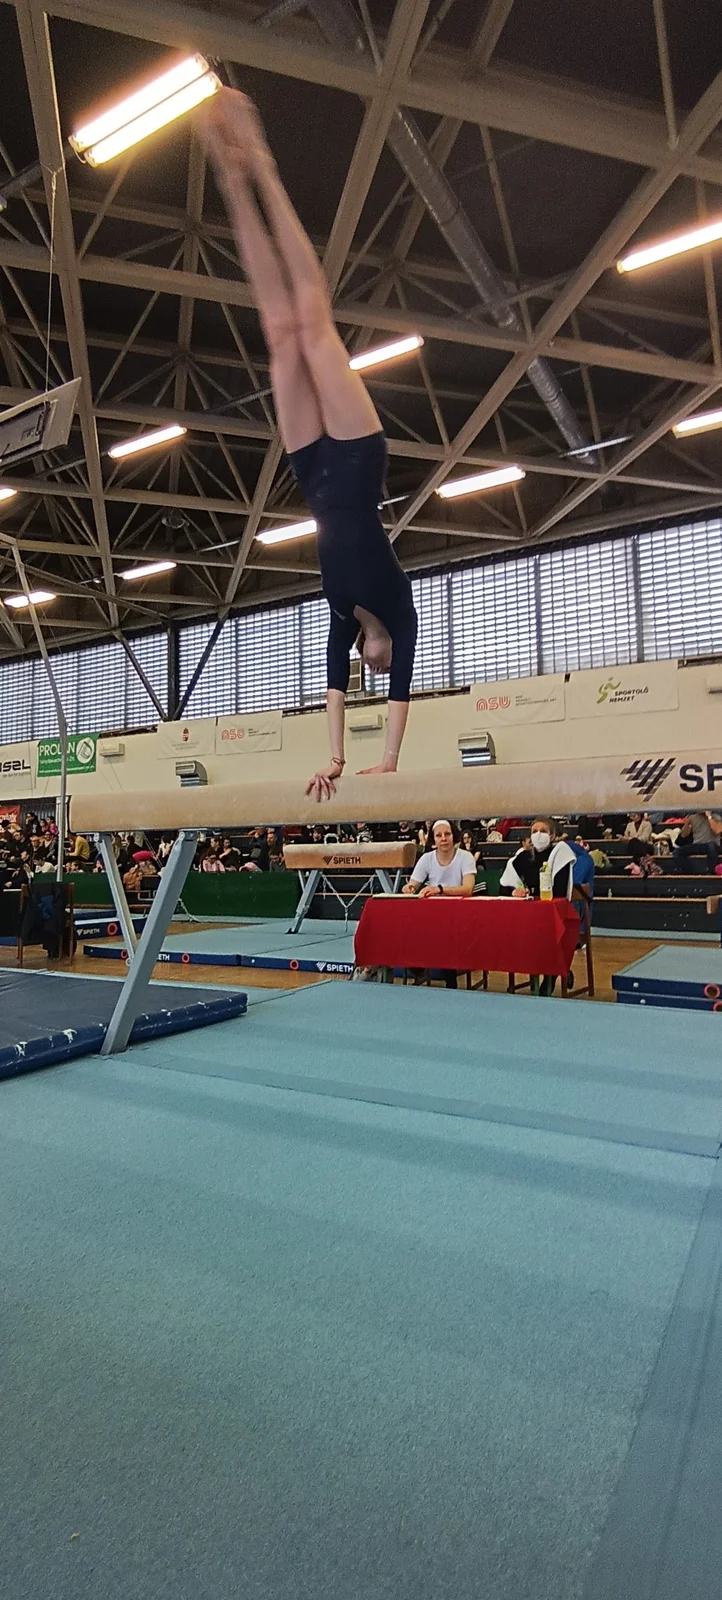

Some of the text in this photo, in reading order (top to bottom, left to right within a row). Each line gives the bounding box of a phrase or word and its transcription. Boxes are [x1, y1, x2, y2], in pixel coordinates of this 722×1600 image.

[39, 741, 76, 756] PROLN
[333, 856, 361, 865] SPIETH
[157, 953, 170, 961] ETH
[326, 963, 354, 973] SPIETH
